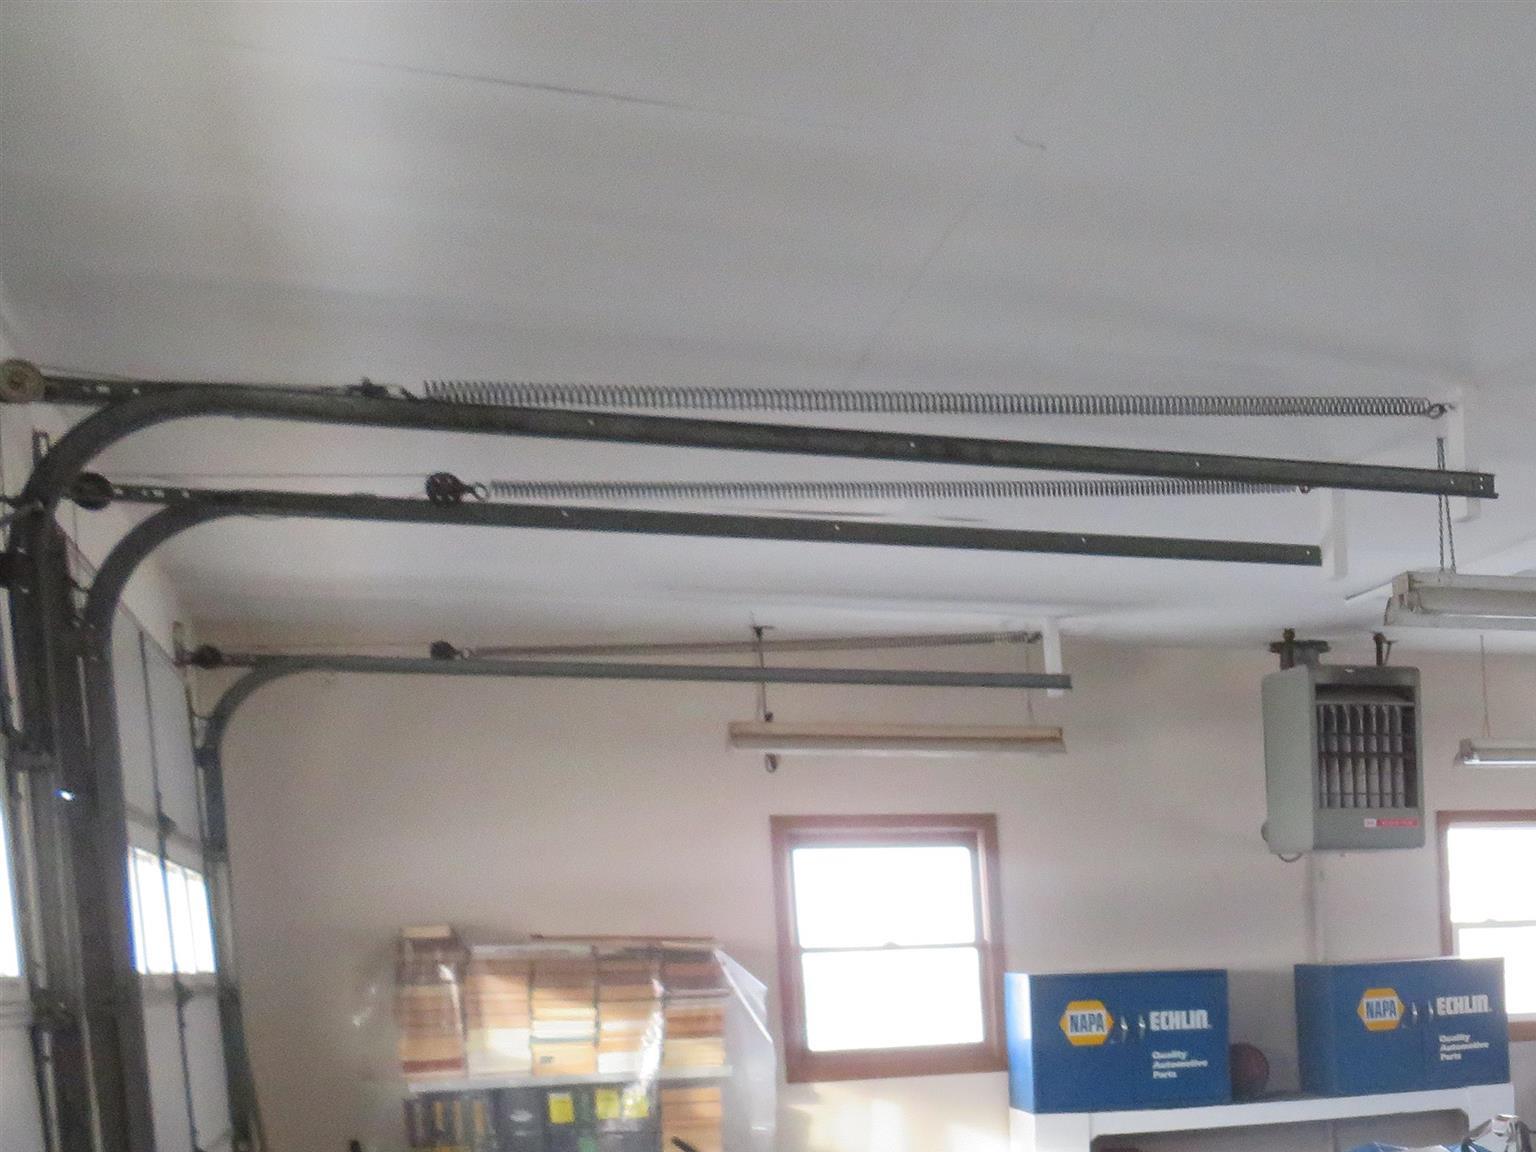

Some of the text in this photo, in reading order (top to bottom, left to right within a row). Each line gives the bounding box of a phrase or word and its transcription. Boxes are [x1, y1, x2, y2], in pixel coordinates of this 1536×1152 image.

[1365, 995, 1489, 1019] NAPA ECHLIN
[1069, 1009, 1208, 1034] NAPA ECHLIN
[1439, 1033, 1470, 1043] Quality
[1152, 1050, 1187, 1060] Quality
[1440, 1052, 1462, 1061] Parts
[1152, 1070, 1177, 1079] Parts
